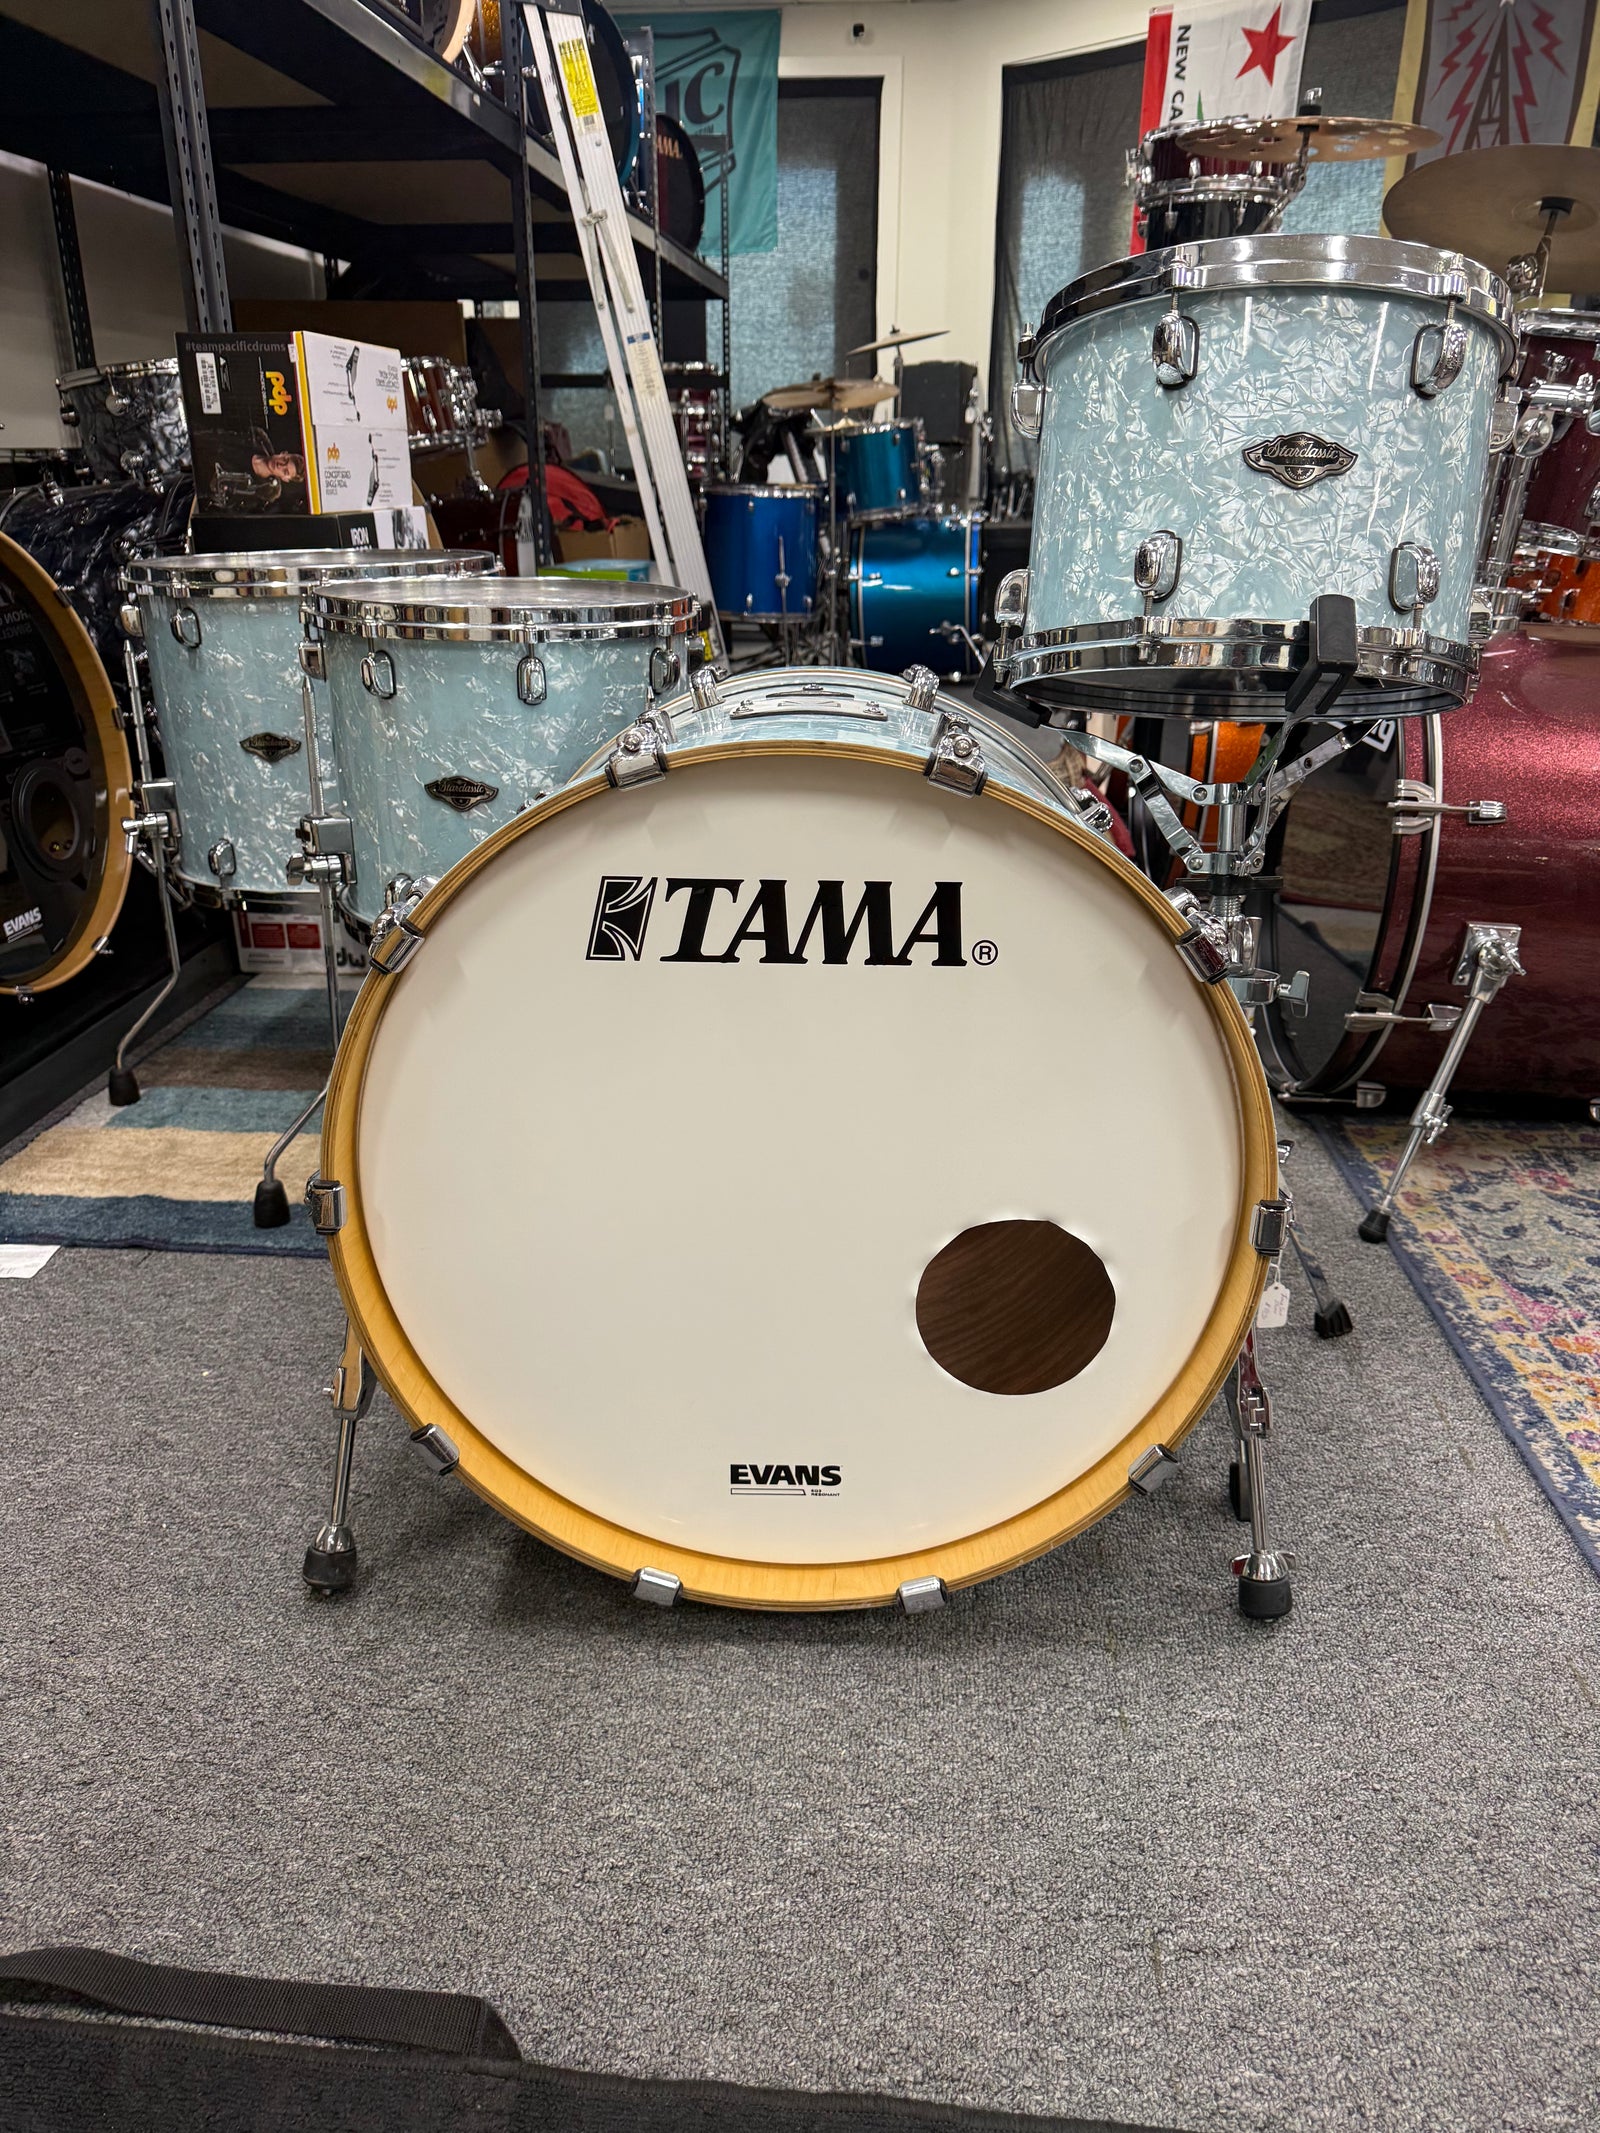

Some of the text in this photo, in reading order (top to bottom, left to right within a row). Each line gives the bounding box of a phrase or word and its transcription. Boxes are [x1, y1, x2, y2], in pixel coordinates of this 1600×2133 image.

[1175, 24, 1192, 81] NEW
[185, 341, 286, 353] #teampacificdrums
[265, 371, 292, 415] pdp
[1264, 440, 1339, 459] Starclassic
[350, 527, 369, 545] IRON
[3, 906, 42, 937] EVANS
[660, 877, 967, 966] TAMA
[730, 1464, 841, 1486] EVANS
